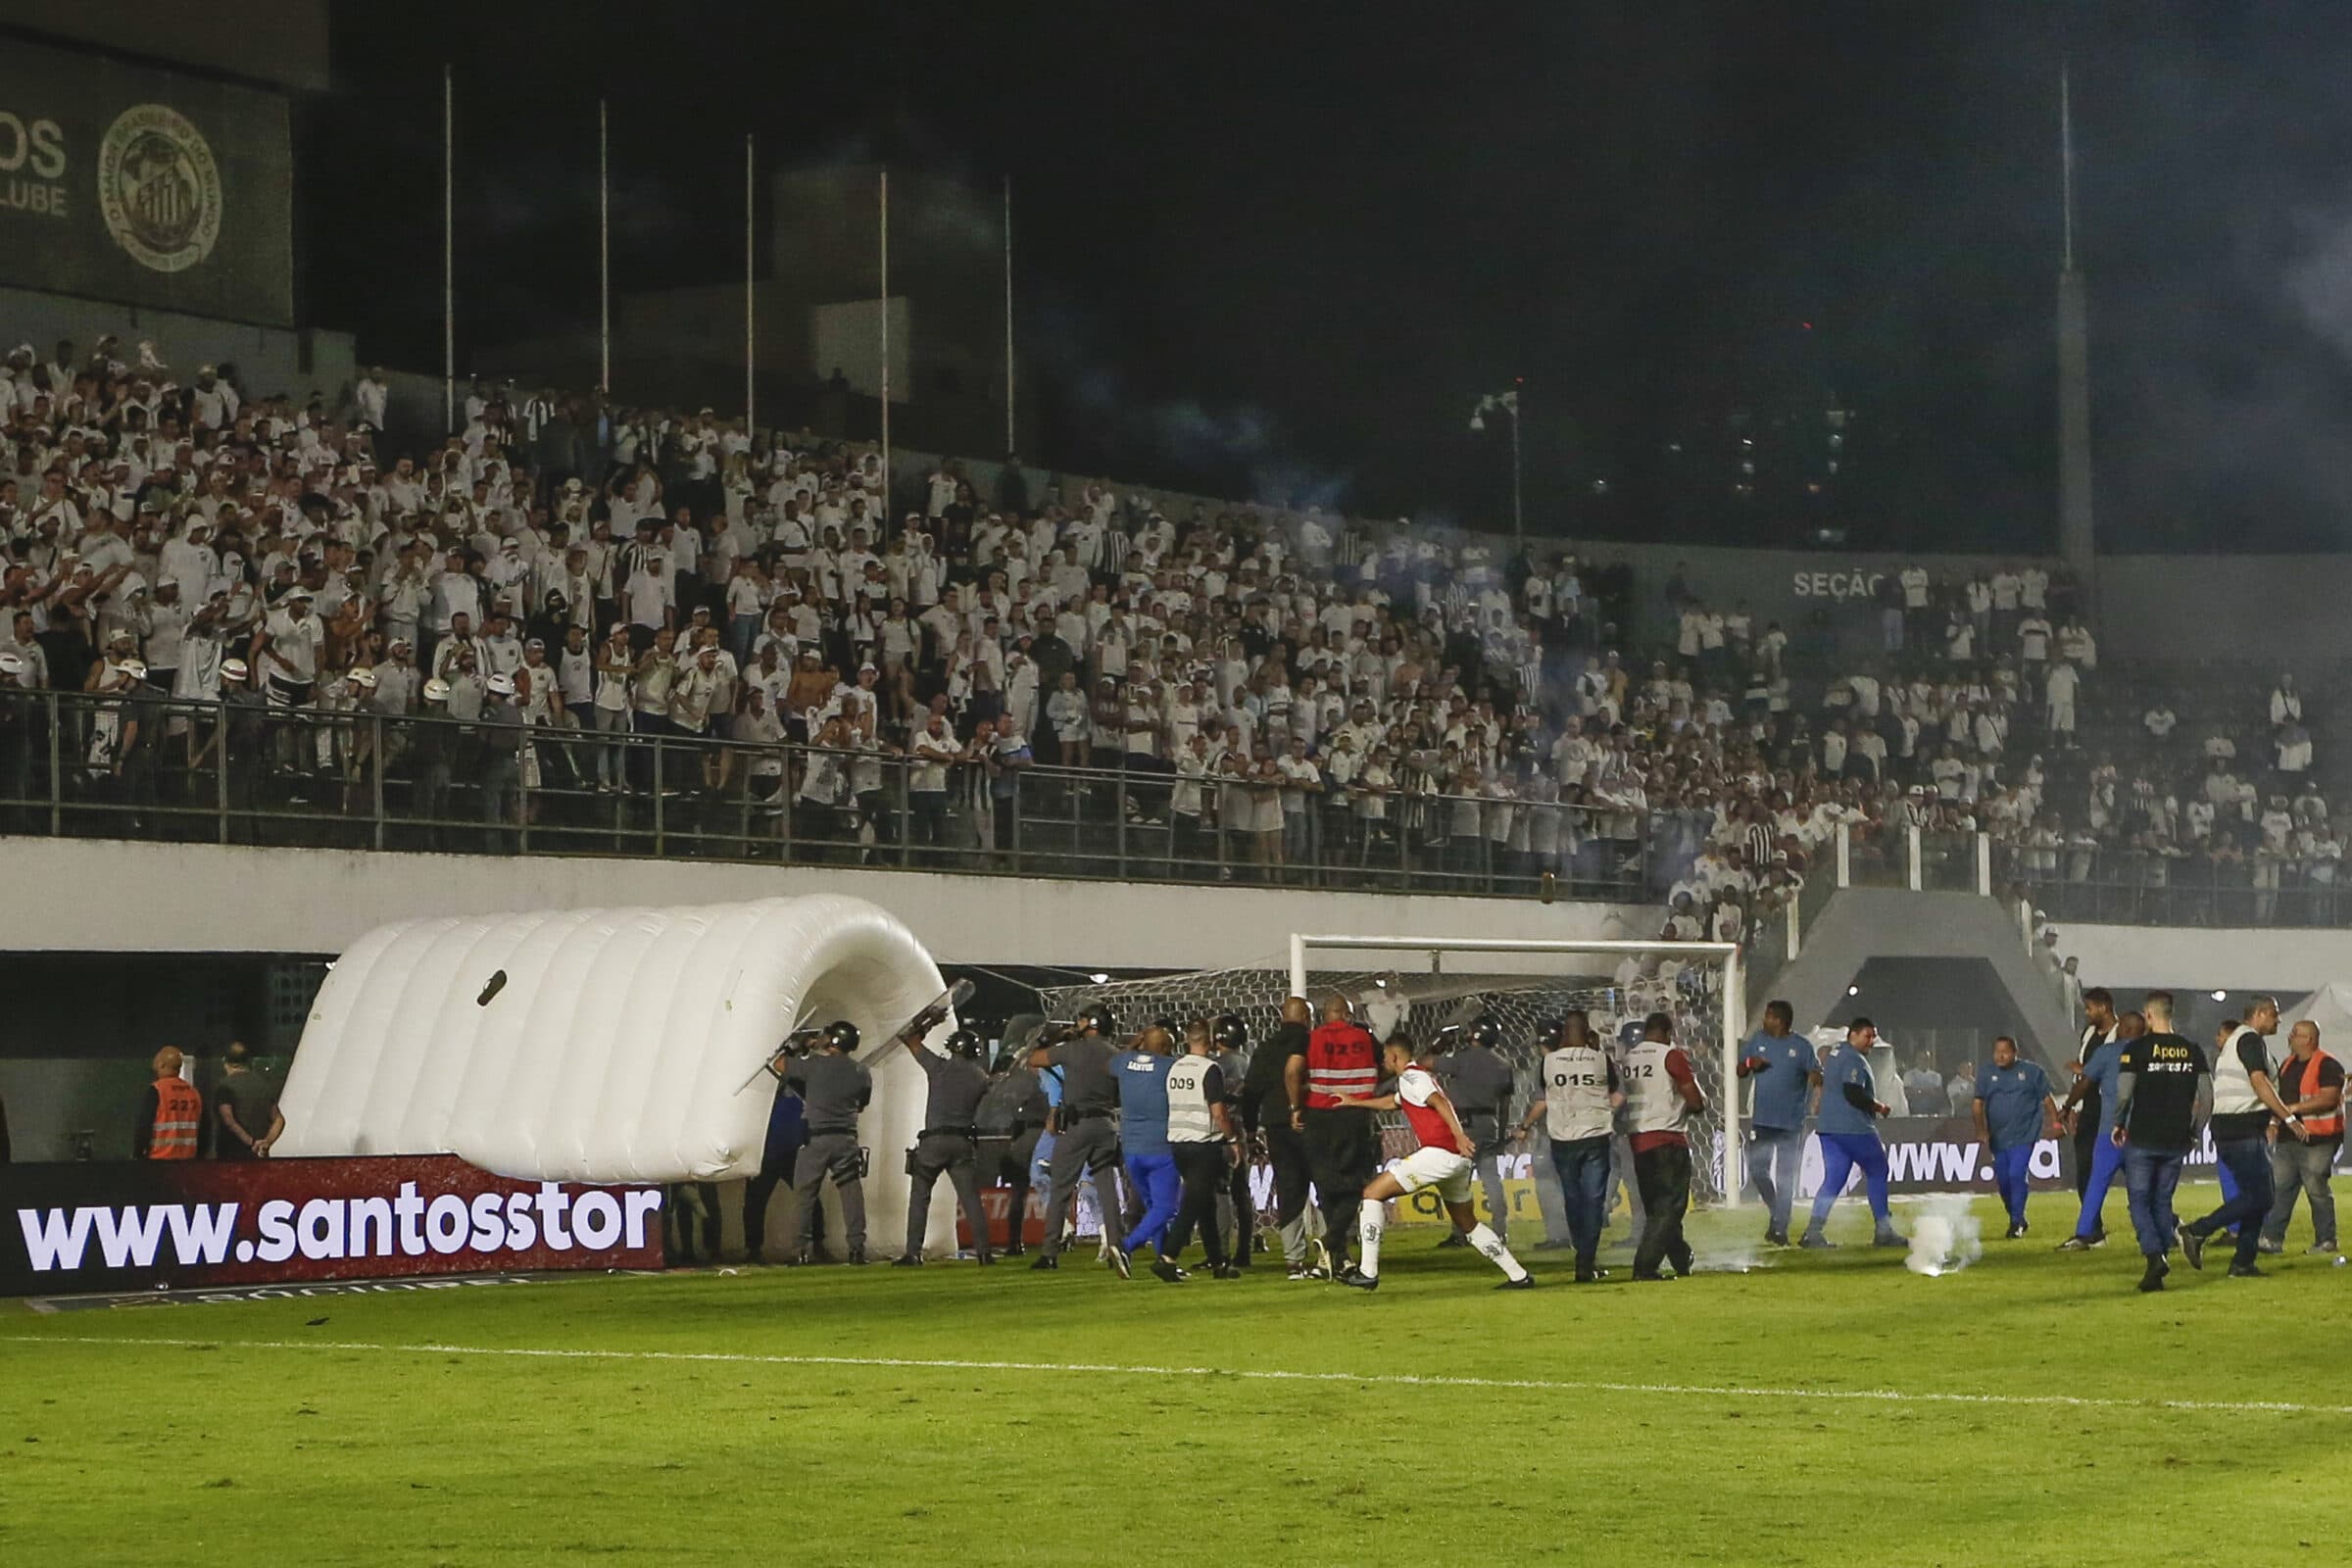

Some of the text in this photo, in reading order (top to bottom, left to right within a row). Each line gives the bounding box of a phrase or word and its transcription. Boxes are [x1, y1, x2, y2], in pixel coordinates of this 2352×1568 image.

[0, 180, 68, 218] UBE
[2152, 1043, 2189, 1060] Apoio
[1623, 1064, 1653, 1079] 012
[1169, 1076, 1195, 1091] 009
[1554, 1074, 1595, 1087] 015
[17, 1180, 662, 1272] www.santosstor
